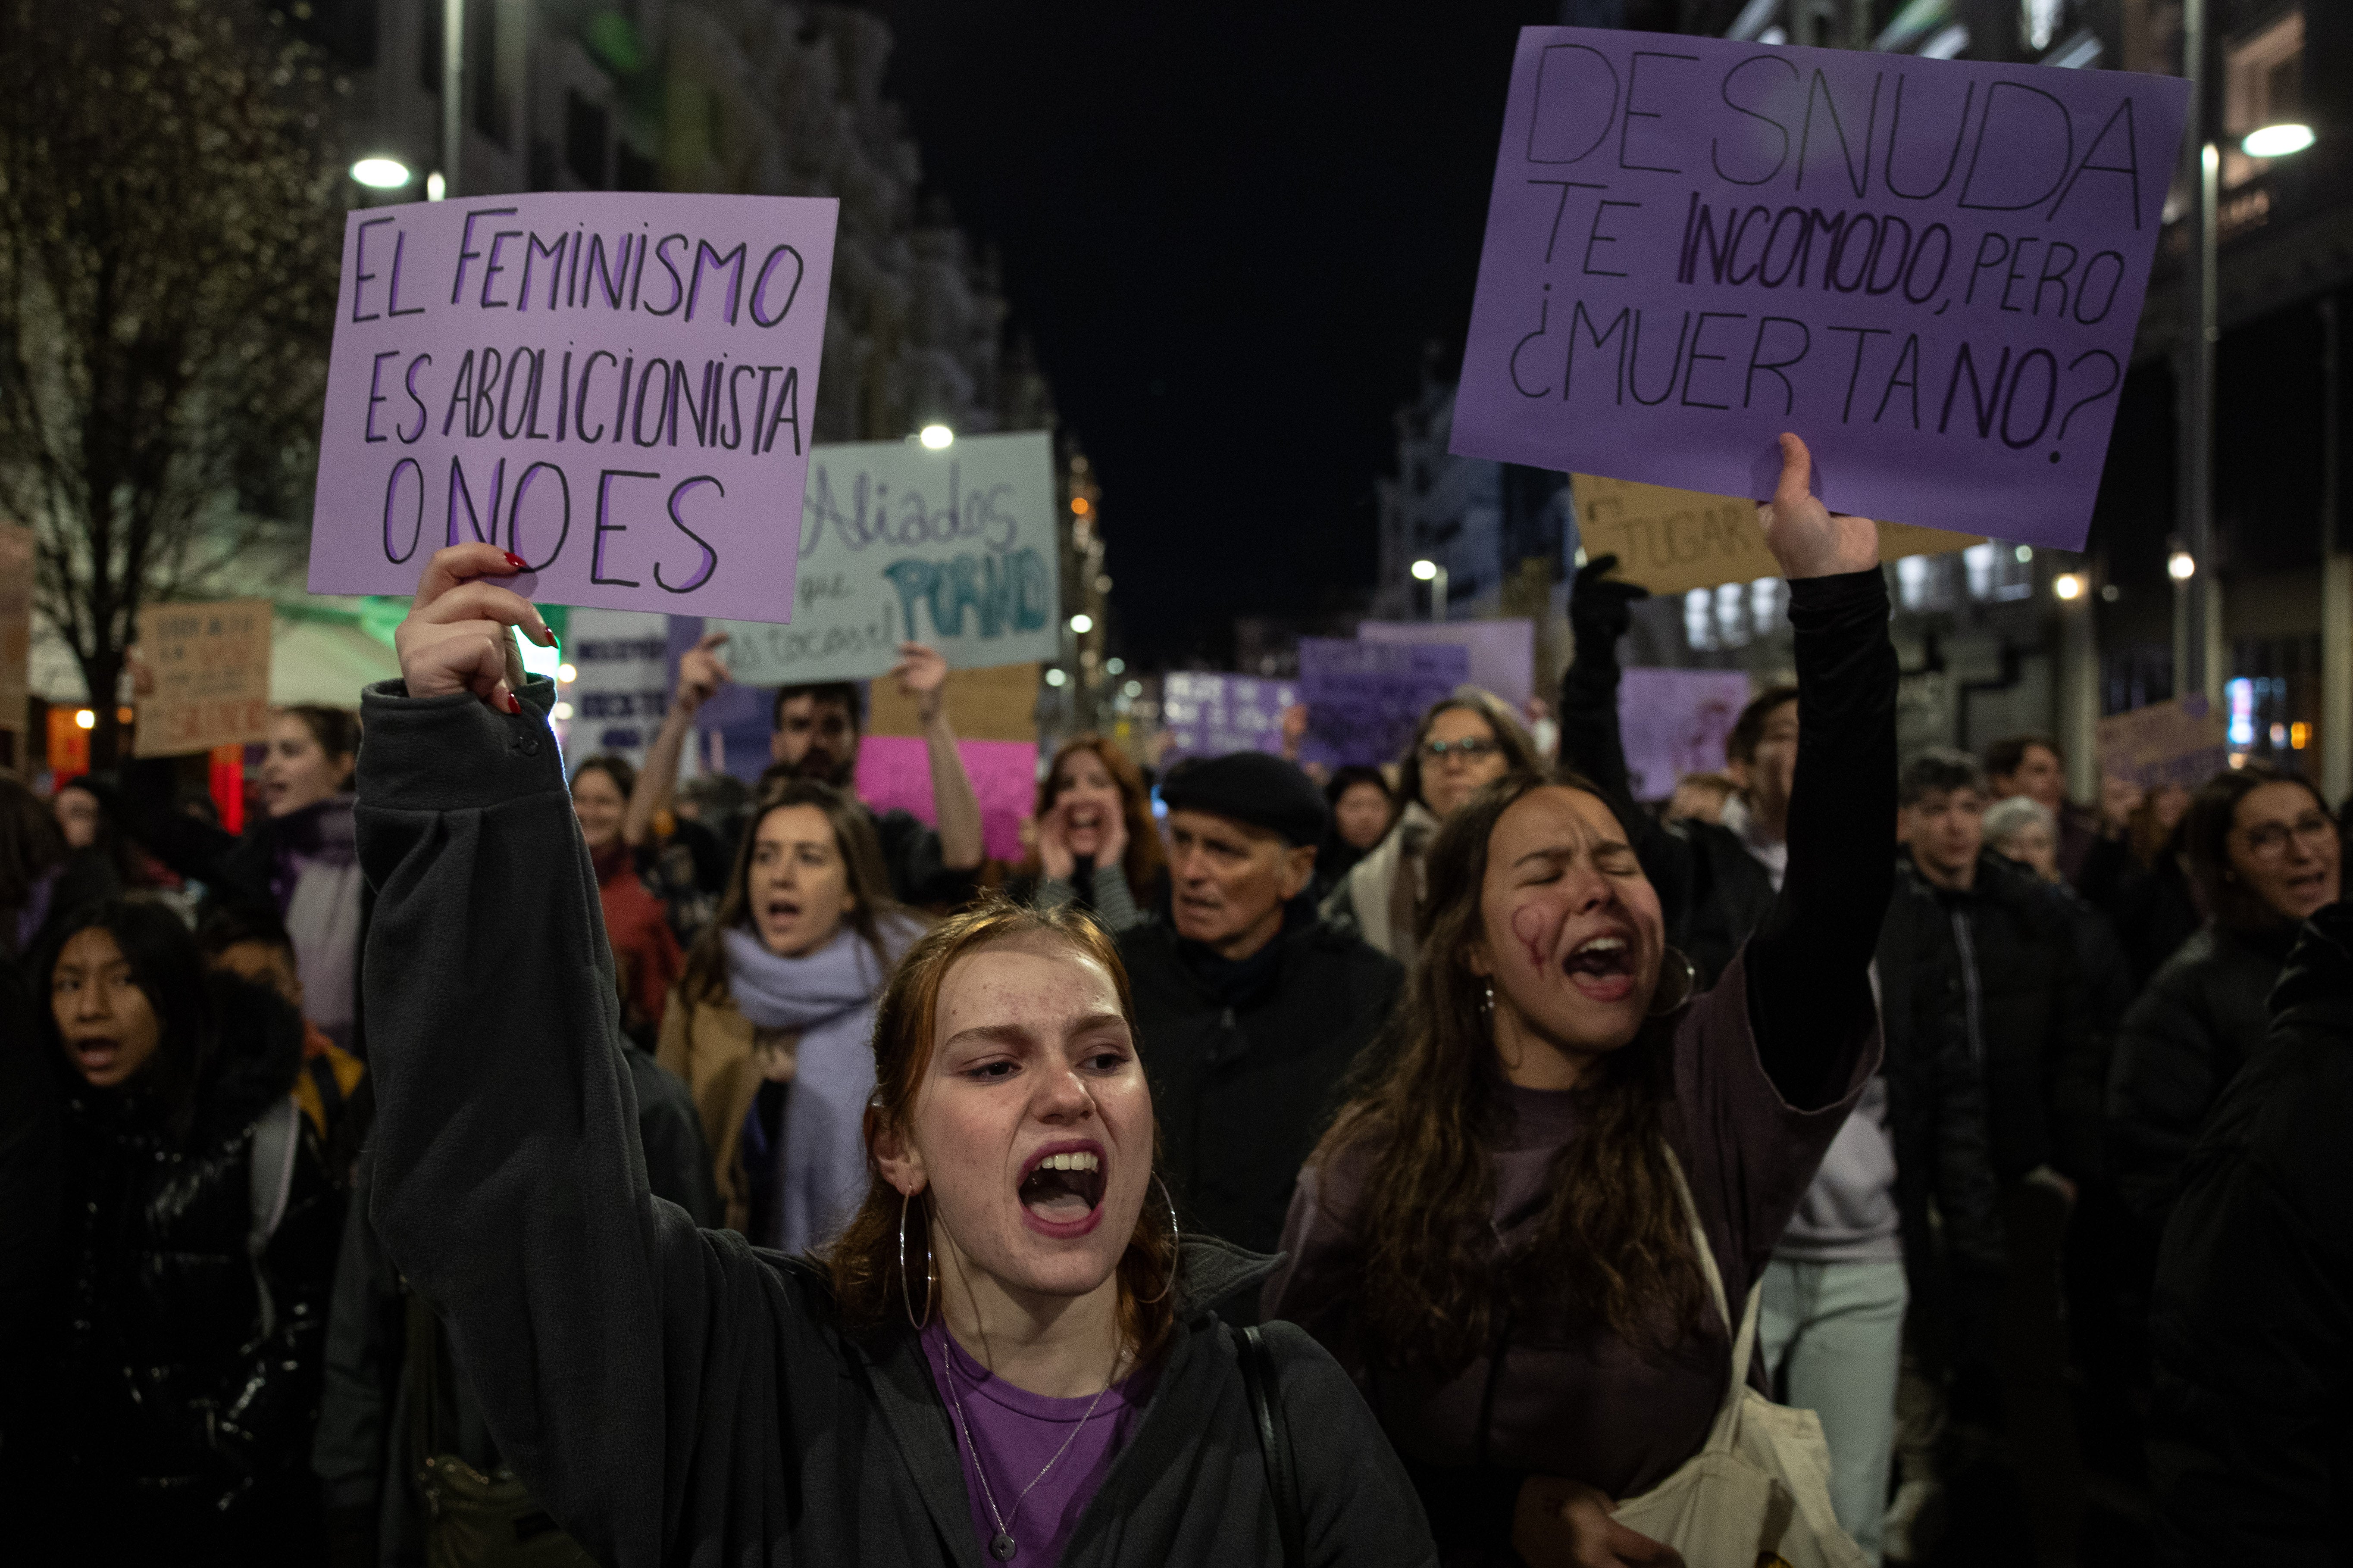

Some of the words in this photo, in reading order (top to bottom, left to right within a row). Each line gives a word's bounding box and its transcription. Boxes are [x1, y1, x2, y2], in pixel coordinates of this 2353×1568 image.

[1526, 43, 2141, 230] DESNUDA
[353, 216, 426, 323] EL
[1527, 179, 1642, 278] TE
[1677, 190, 1953, 317] INCOMODO,
[1965, 231, 2126, 325] PERO
[365, 350, 432, 445] ES
[1938, 340, 2121, 465] NO?
[383, 457, 424, 565] O
[446, 455, 570, 573] NO
[591, 469, 725, 594] ES
[796, 460, 1018, 559] Aliados
